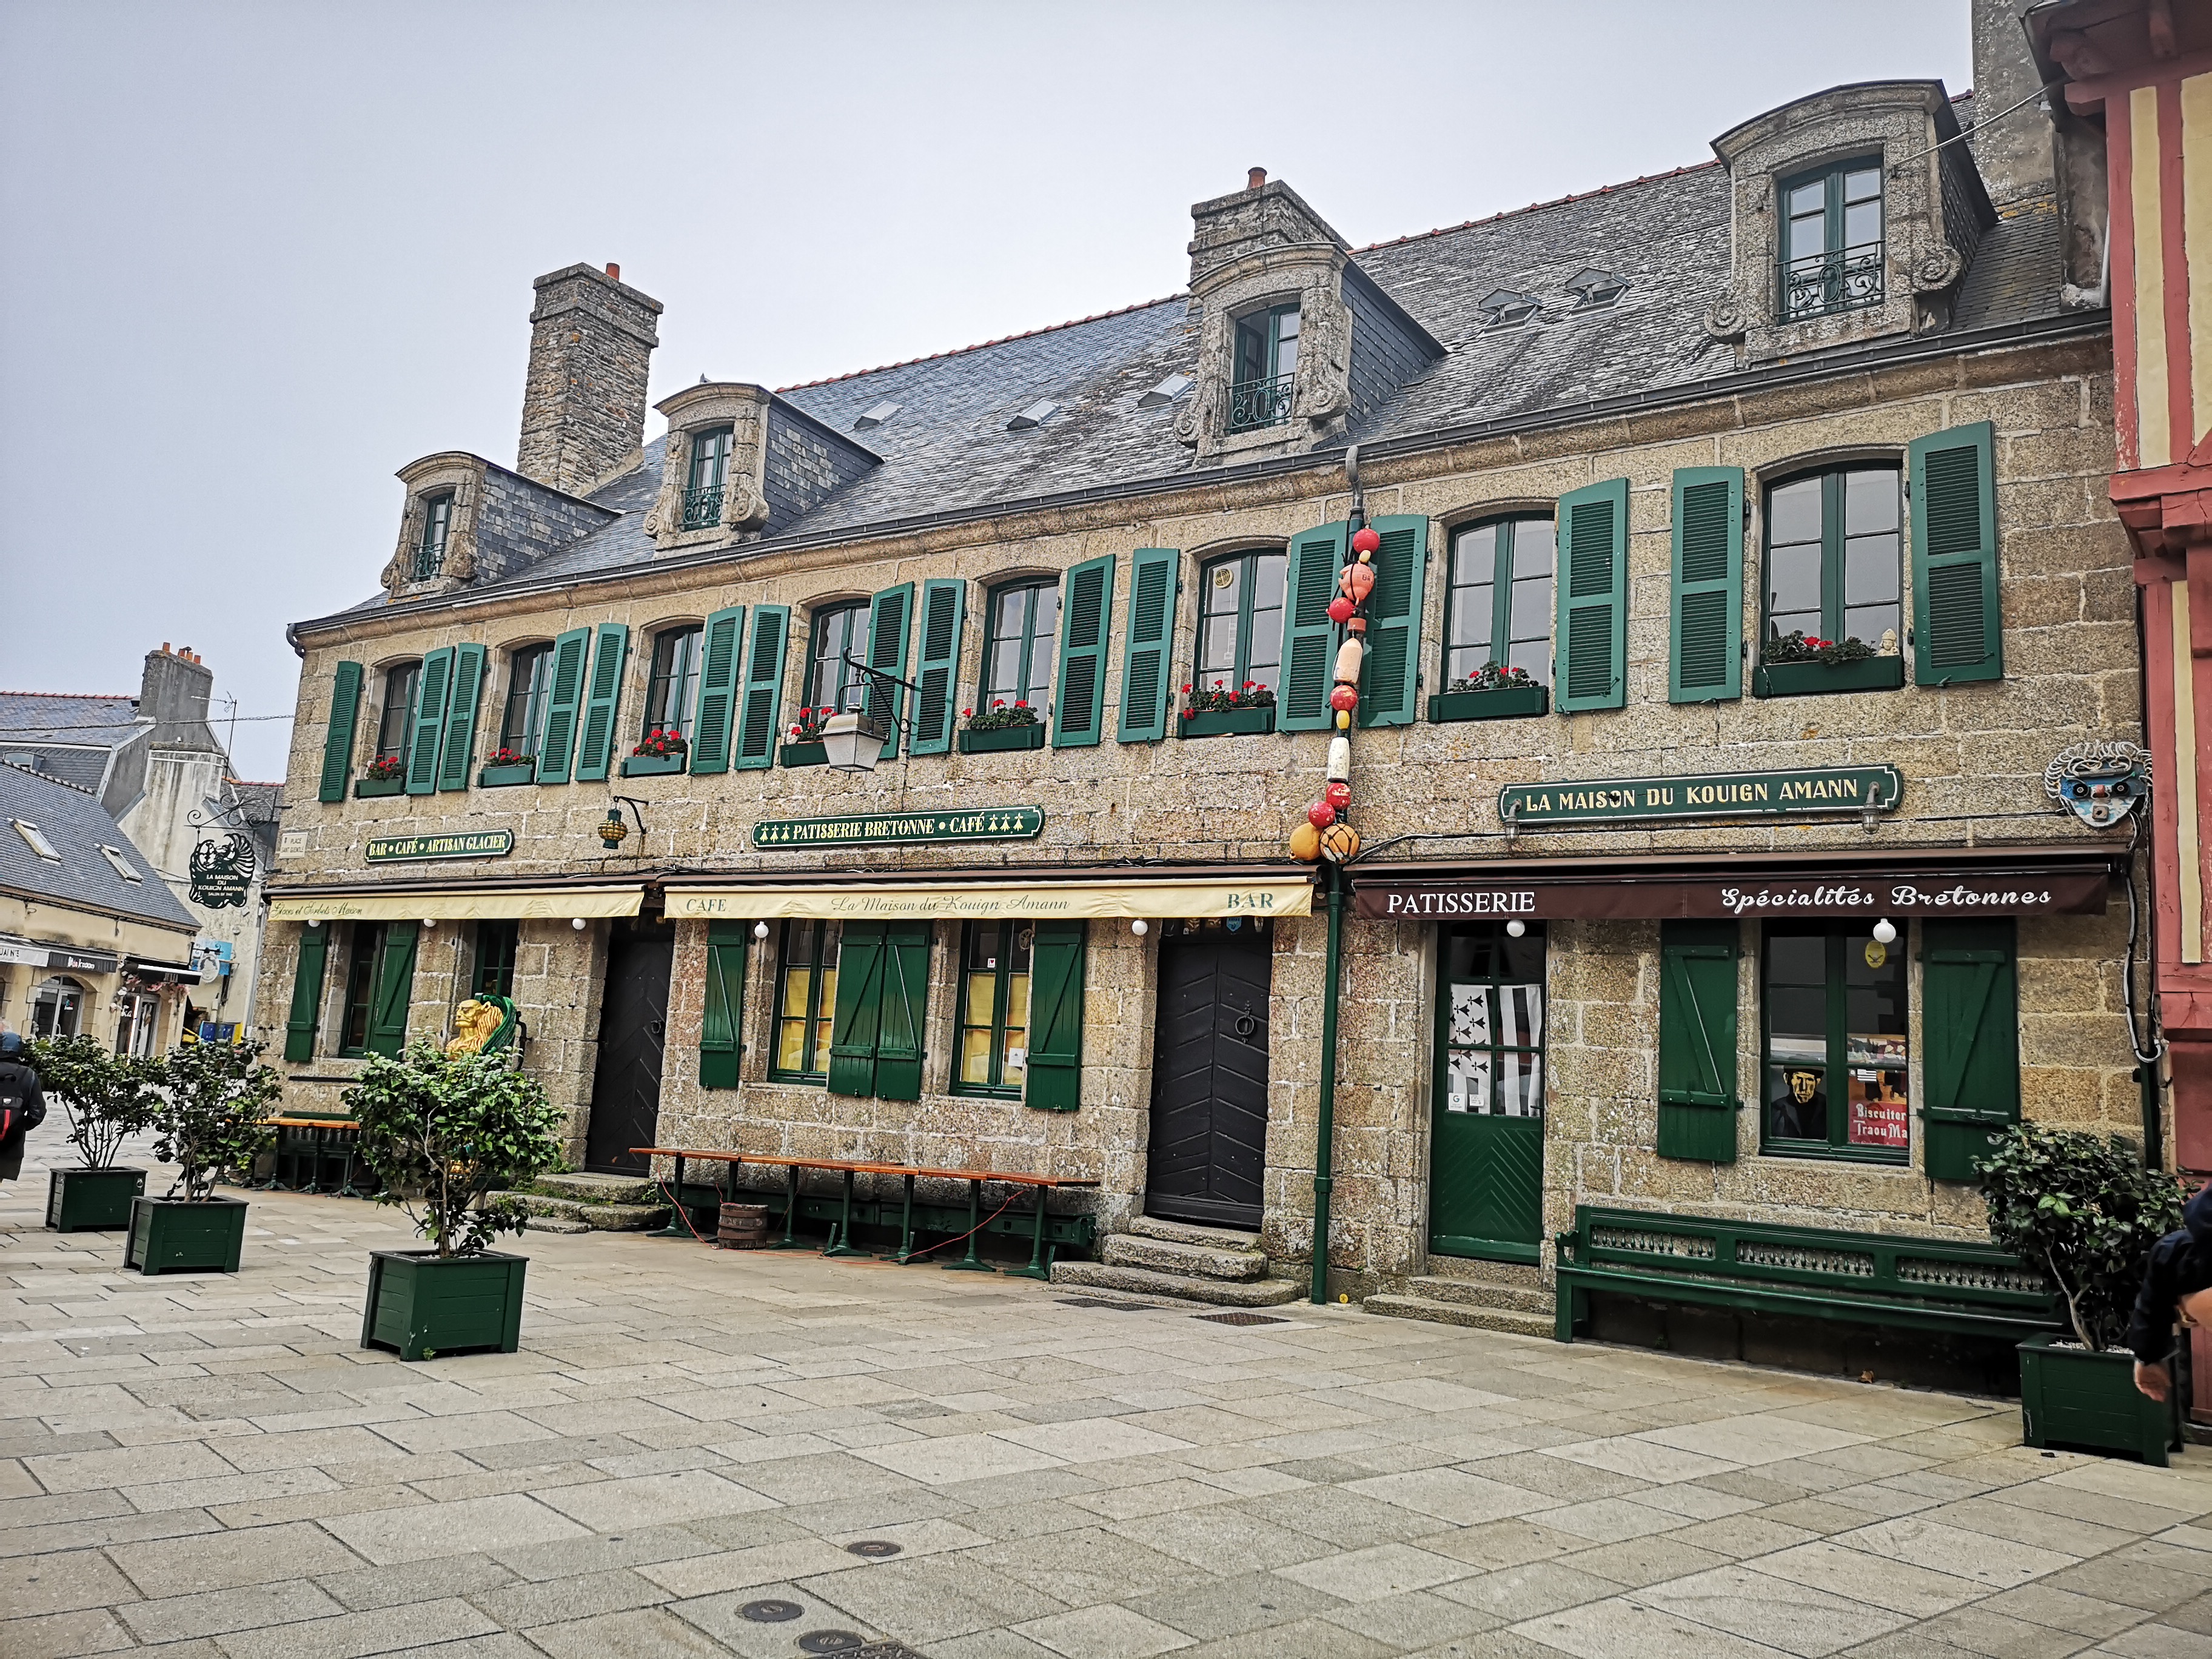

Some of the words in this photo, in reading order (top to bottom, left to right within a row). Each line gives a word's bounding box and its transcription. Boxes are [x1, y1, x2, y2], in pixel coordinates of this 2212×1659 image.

[1526, 794, 1551, 811] LA
[1559, 789, 1635, 811] MAISON
[1646, 787, 1674, 806] DU
[1686, 783, 1768, 804] KOUIGN
[1779, 779, 1857, 800] AMANN
[793, 822, 862, 840] PATISSERIE
[864, 818, 935, 837] BRETONNE
[950, 811, 985, 833] CAFÉ
[369, 843, 387, 856] BAR
[395, 837, 418, 854] CAFÉ
[426, 837, 465, 853] ARTISAN
[466, 834, 506, 850] GLACIER
[332, 900, 363, 917] Maison
[686, 899, 726, 911] CAFE
[831, 896, 857, 911] La
[862, 896, 917, 911] Maison
[919, 897, 939, 911] du
[943, 895, 1000, 916] Kouign
[1006, 894, 1070, 910] Amann
[1227, 893, 1273, 908] BAR
[1387, 891, 1535, 914] PATISSERIE
[1721, 885, 1875, 914] Spécialités
[1891, 885, 2052, 907] Bretonnes
[1853, 1119, 1887, 1137] Traou
